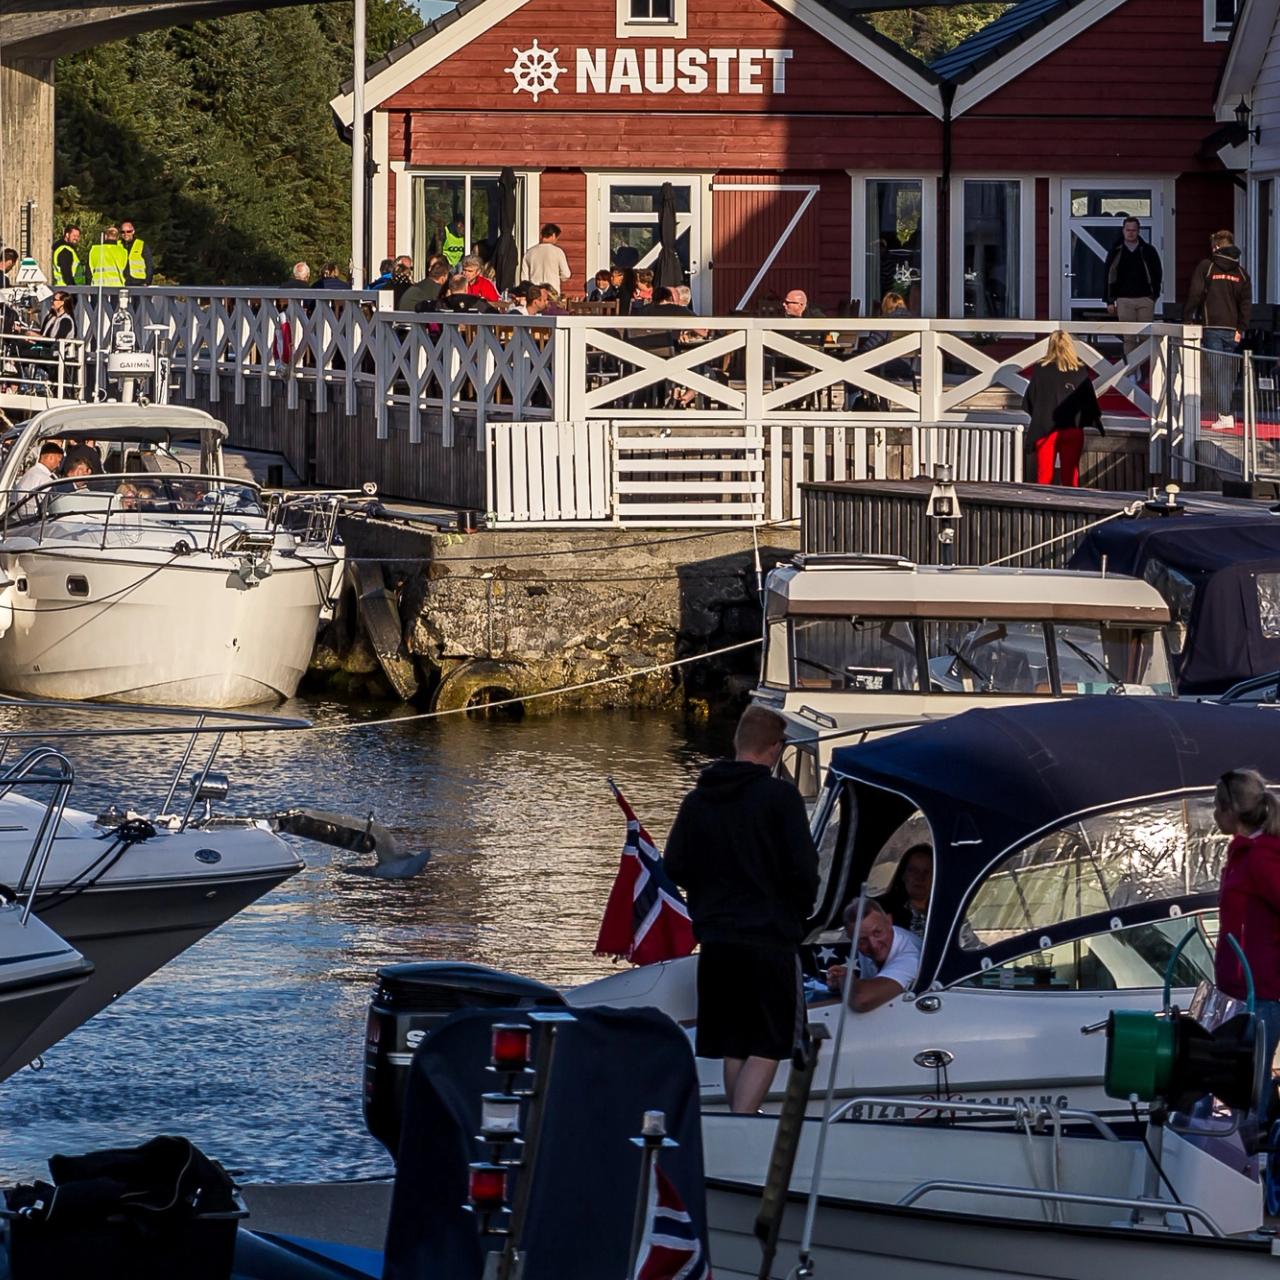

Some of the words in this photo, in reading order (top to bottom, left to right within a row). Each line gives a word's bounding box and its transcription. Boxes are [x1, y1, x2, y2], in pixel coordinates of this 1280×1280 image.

[576, 48, 794, 94] NAUSTET
[21, 268, 38, 279] 77
[406, 1029, 427, 1049] S
